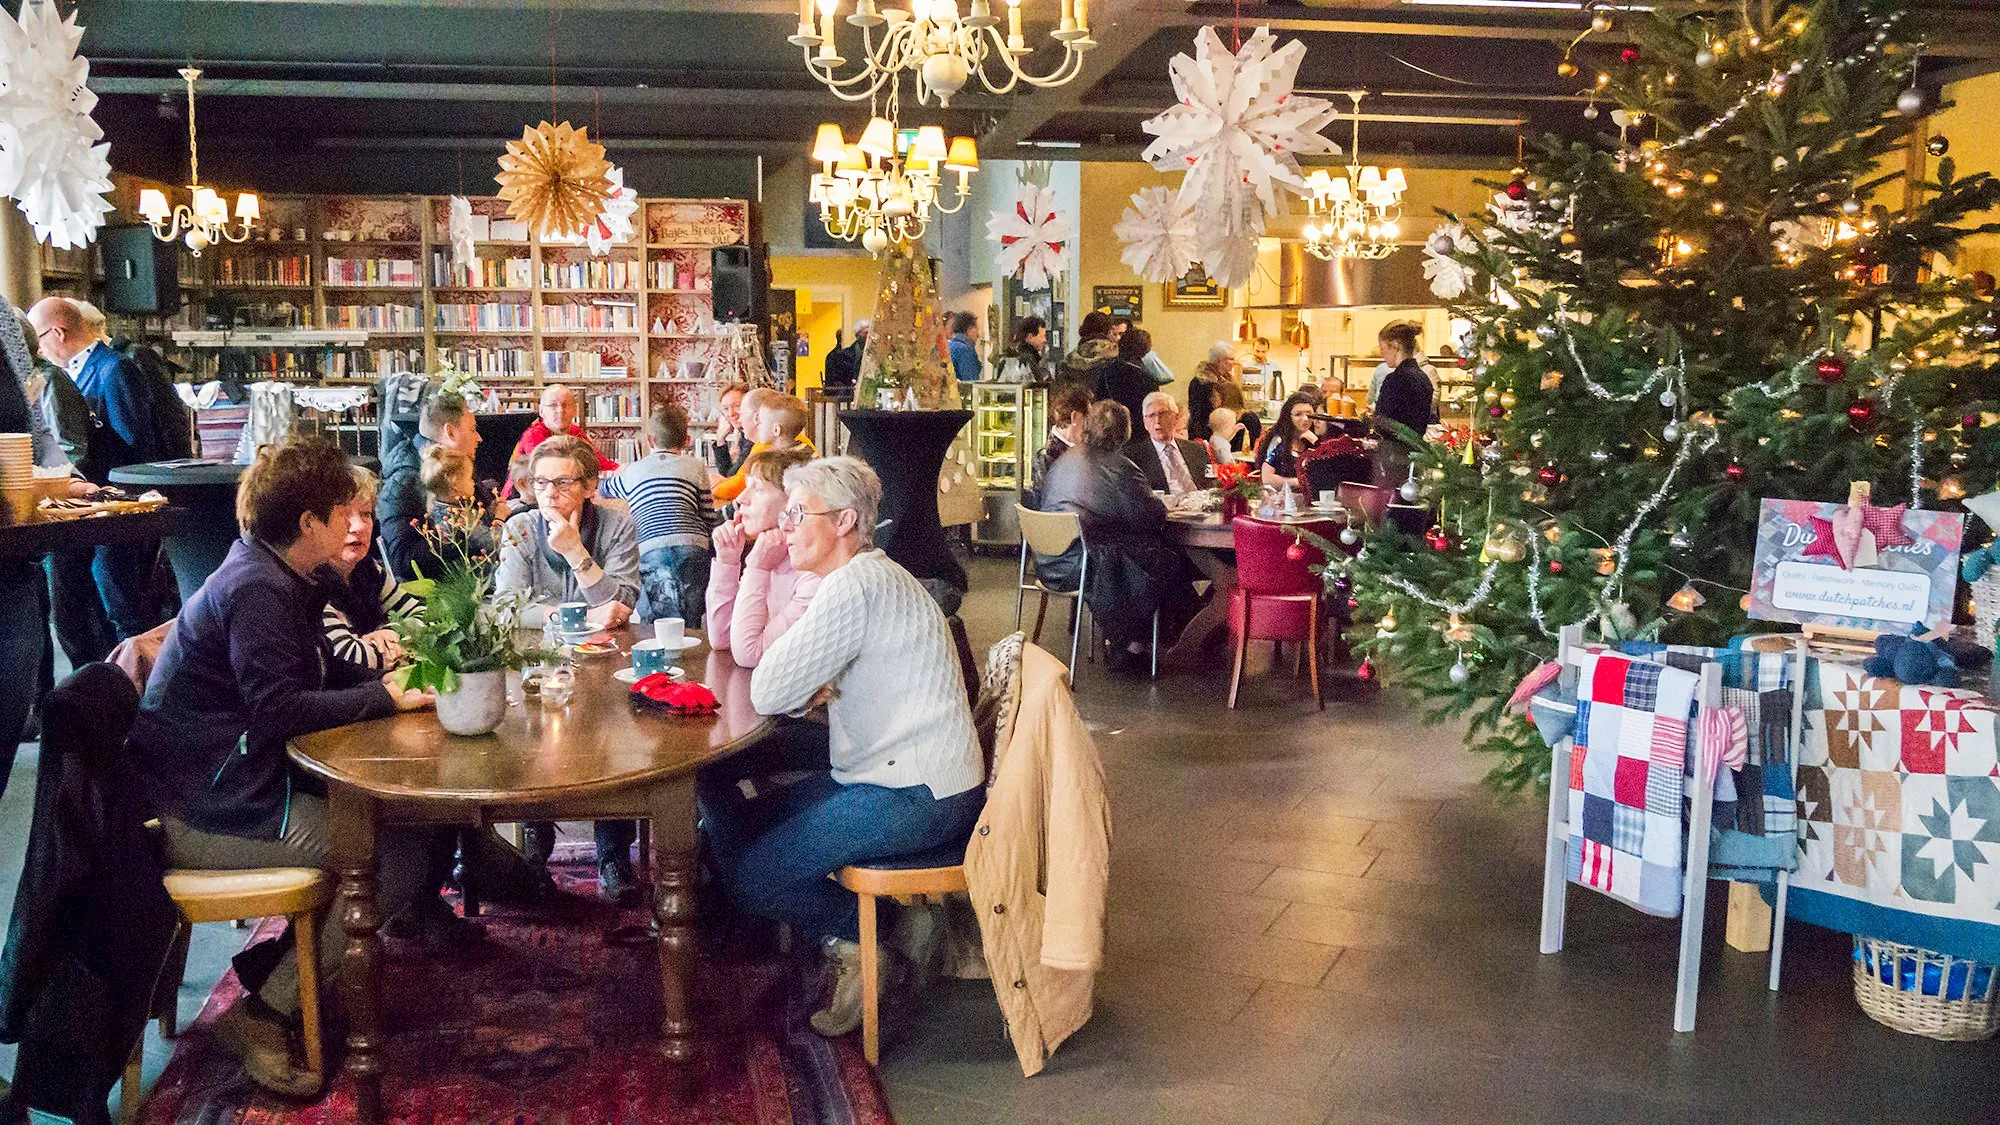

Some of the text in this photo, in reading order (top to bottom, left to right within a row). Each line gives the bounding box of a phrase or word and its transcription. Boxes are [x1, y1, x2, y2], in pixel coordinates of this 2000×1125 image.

[1862, 579, 1896, 591] Memory
[1897, 582, 1922, 592] Quilts
[1785, 590, 1915, 611] www.dutchpatches.nl
